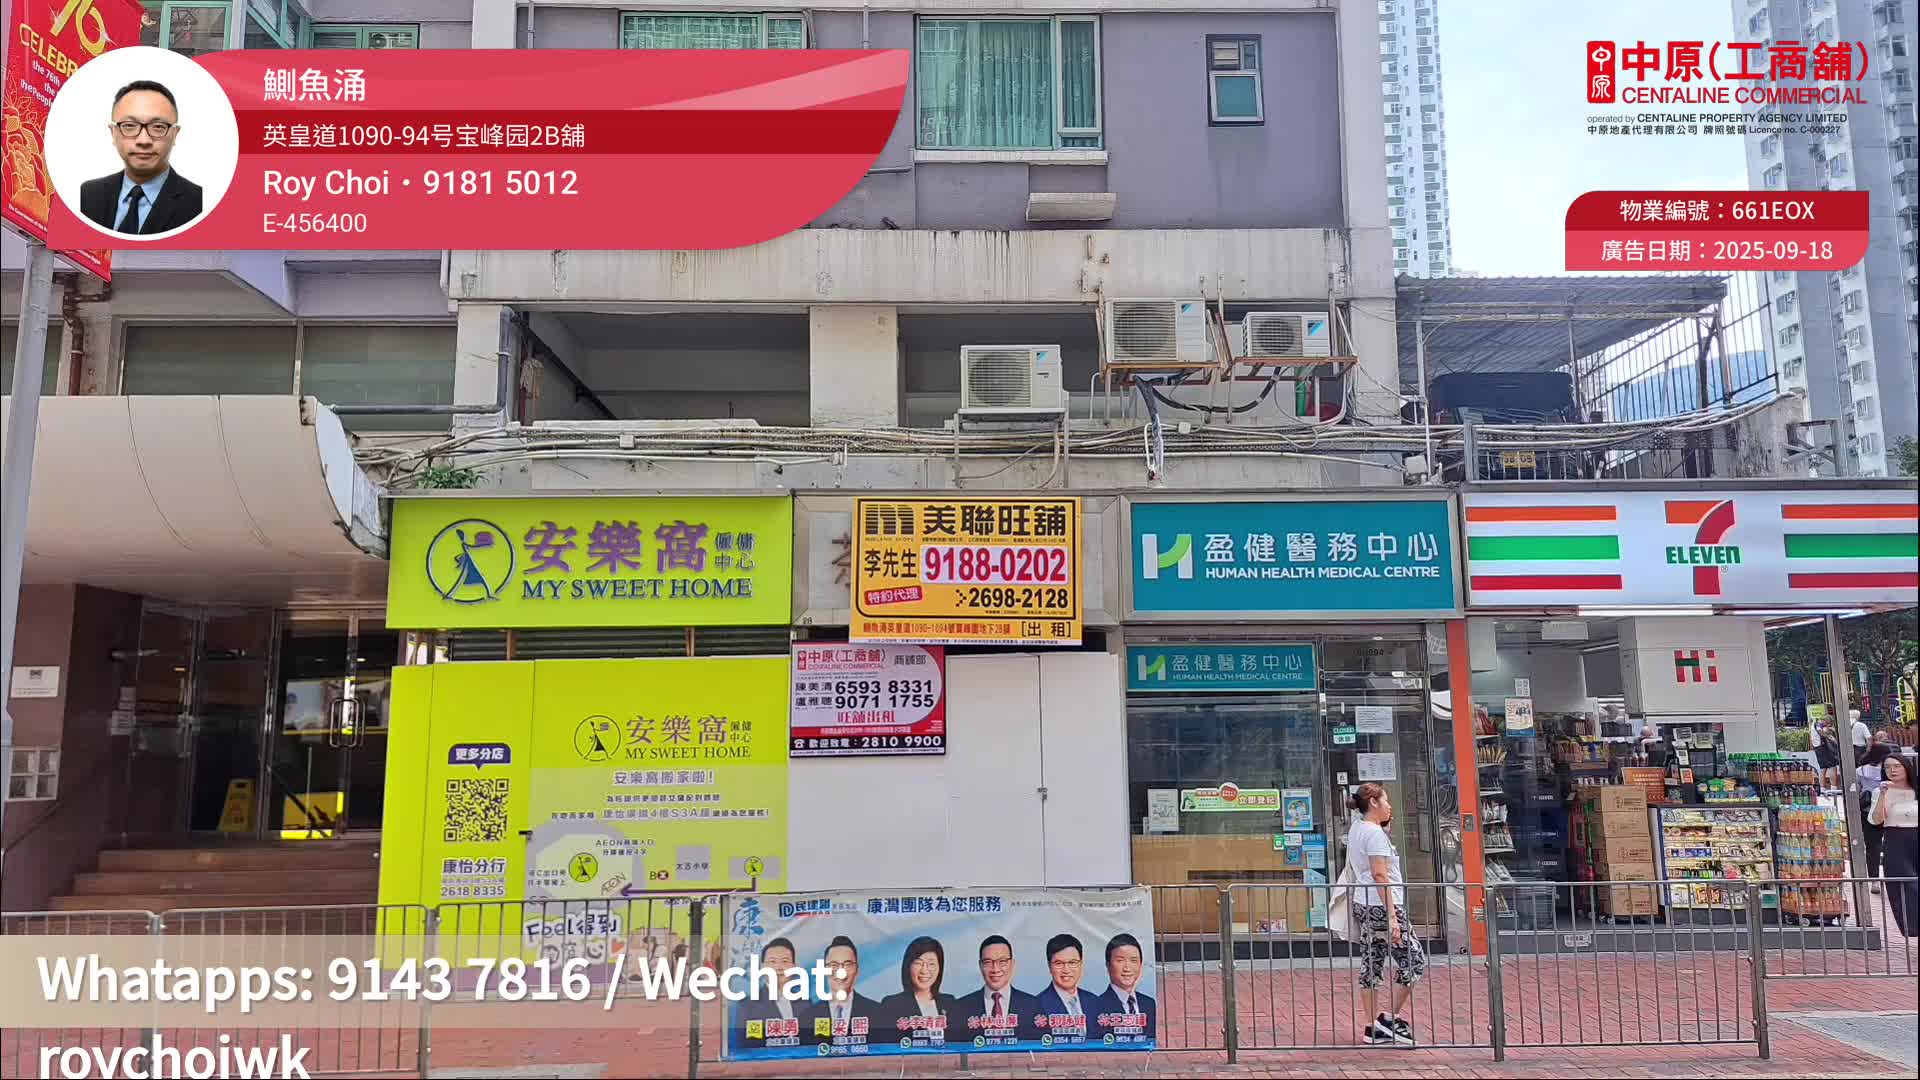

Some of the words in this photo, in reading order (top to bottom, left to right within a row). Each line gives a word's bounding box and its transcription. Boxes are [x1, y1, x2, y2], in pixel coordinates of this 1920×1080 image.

[922, 505, 1067, 536] 美聯旺舖
[523, 519, 710, 575] 安樂窩
[1203, 532, 1439, 563] 盈健醫務中心
[1664, 499, 1736, 596] 7
[714, 552, 756, 573] 中心
[863, 548, 917, 579] 李先生
[924, 547, 1068, 582] 9188-0202
[1206, 567, 1259, 579] HUMAN
[1262, 567, 1315, 579] HEALTH
[1318, 566, 1380, 578] MEDICAL
[1383, 566, 1440, 578] CENTRE
[522, 579, 568, 600] MY
[571, 579, 665, 600] SWEET
[670, 578, 753, 600] HOME
[867, 586, 920, 605] 特約代理
[968, 588, 1068, 609] 2698-2128
[1171, 654, 1303, 671] 盈健醫務中心
[1674, 650, 1718, 683] Hi
[1173, 673, 1202, 681] HUMAN
[1203, 673, 1234, 681] HEALTH
[1272, 672, 1303, 680] CENTRE
[835, 680, 881, 695] 6593
[888, 679, 933, 694] 8331
[835, 695, 881, 709] 9071
[889, 694, 934, 708] 1755
[626, 714, 728, 745] 安樂窩
[861, 737, 899, 747] 2810
[904, 736, 942, 746] 9900
[455, 748, 505, 760] 更多分店
[625, 748, 649, 760] MY
[650, 747, 700, 759] SWEET
[704, 746, 751, 758] HOME
[441, 886, 471, 896] 2618
[473, 885, 505, 896] 8335
[867, 896, 1001, 914] 康灣團隊為您服務
